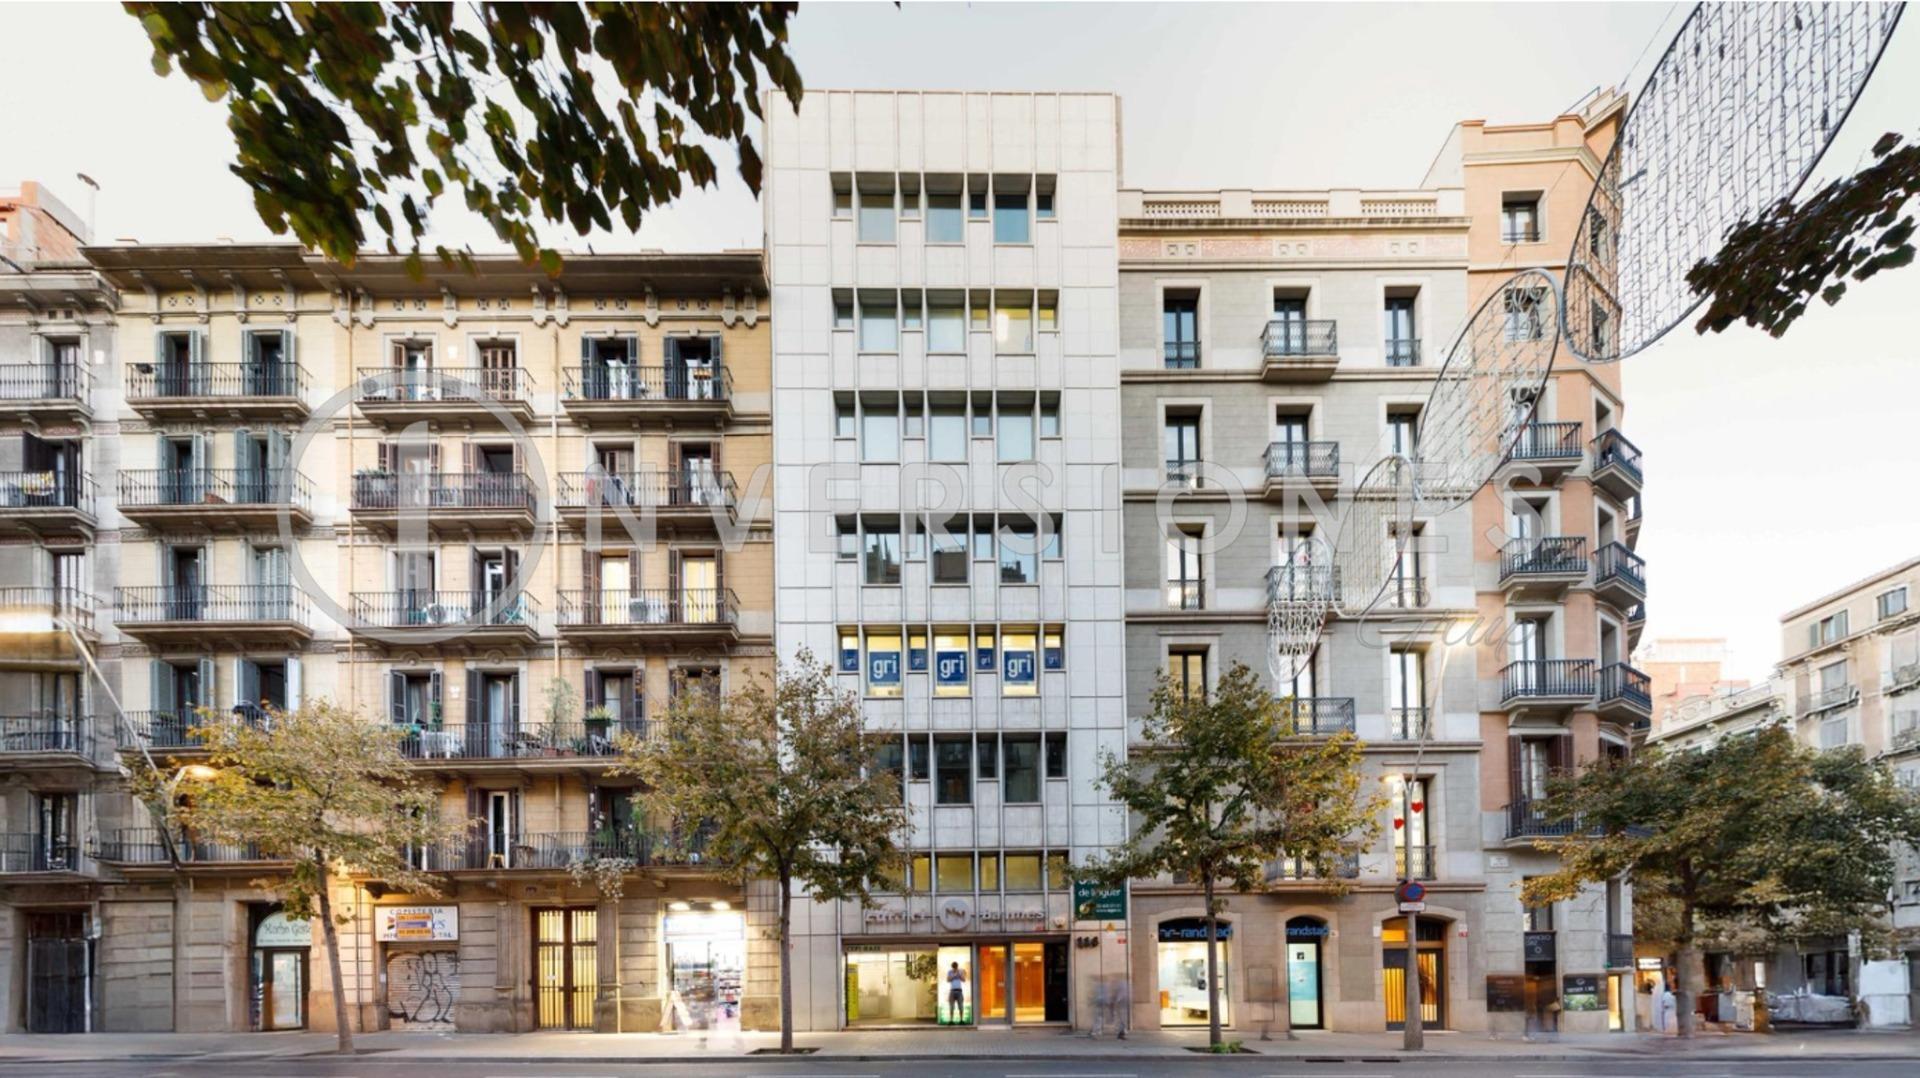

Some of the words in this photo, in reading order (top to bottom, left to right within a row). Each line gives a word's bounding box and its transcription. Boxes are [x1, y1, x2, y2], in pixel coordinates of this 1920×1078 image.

[873, 655, 897, 679] gri
[940, 655, 964, 679] gri
[1006, 654, 1031, 678] gri
[1286, 925, 1330, 936] randstad
